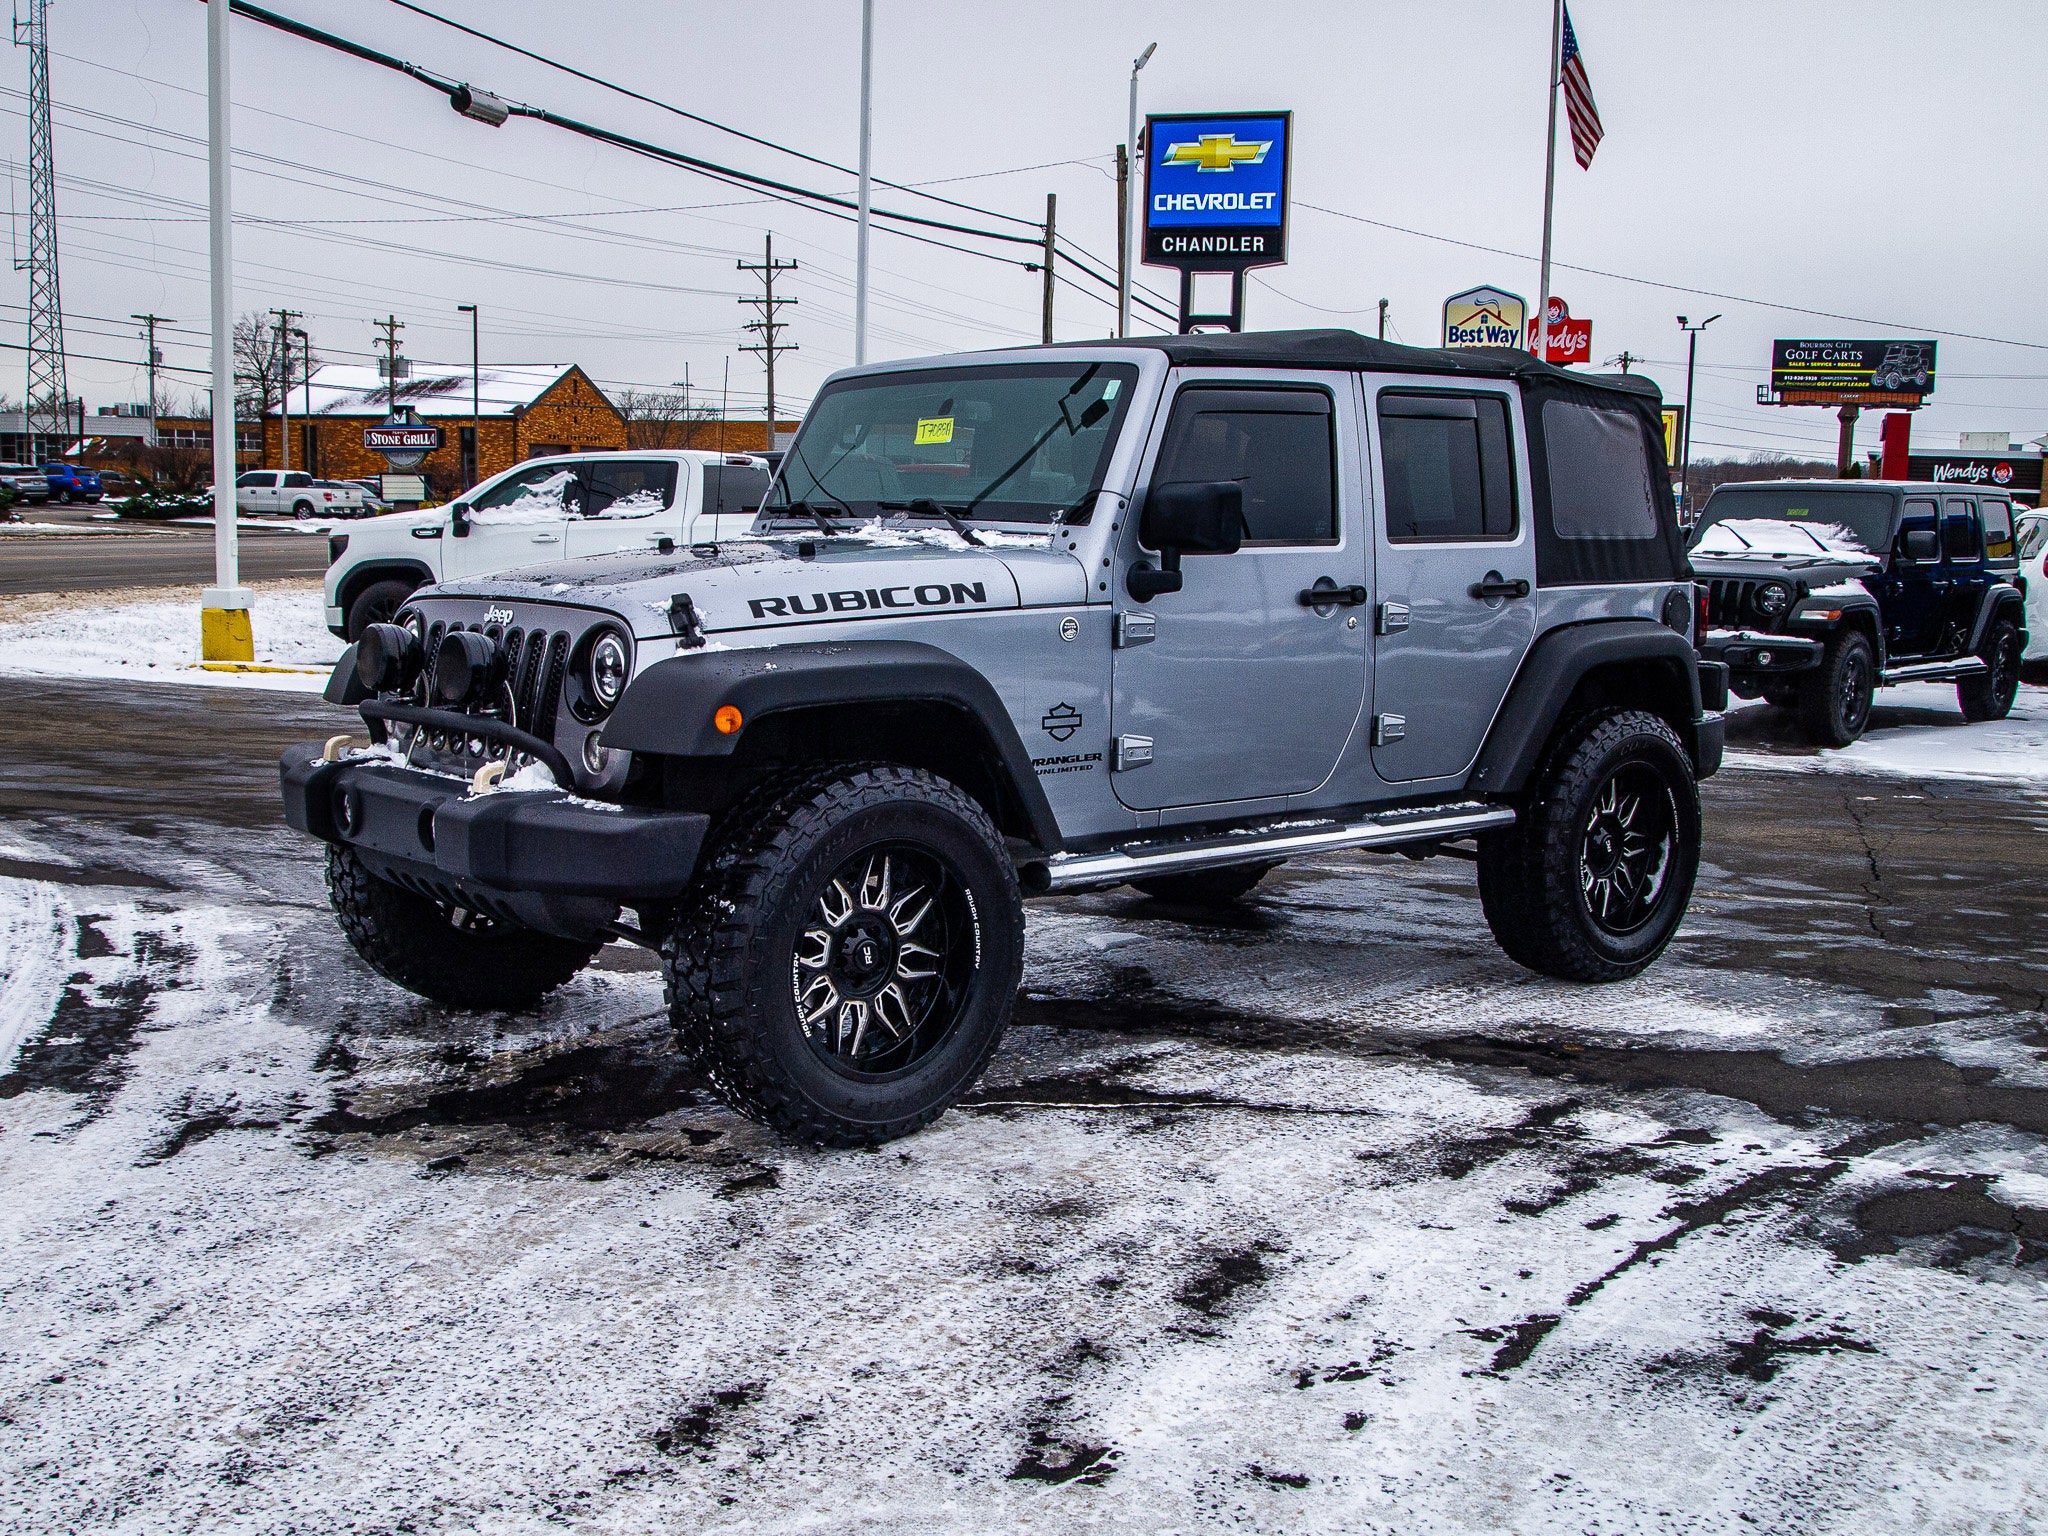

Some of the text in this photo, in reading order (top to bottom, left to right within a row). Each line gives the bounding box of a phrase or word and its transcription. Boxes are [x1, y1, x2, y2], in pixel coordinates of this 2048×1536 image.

[1154, 192, 1276, 211] CHEVROLET
[1162, 236, 1264, 252] CHANDLER
[1448, 326, 1520, 349] Best Way
[1800, 341, 1853, 349] BOURBON CITY
[1785, 349, 1863, 360] GOLF CARTS
[371, 432, 400, 445] STONE
[403, 433, 431, 445] GRILL
[1933, 461, 1989, 483] Wendy's
[747, 581, 987, 619] RUBICON
[484, 604, 514, 627] Jeep
[1035, 764, 1093, 775] UNLIMITED
[964, 888, 981, 970] ROUGH COUNTRY
[863, 946, 873, 965] RC
[792, 952, 812, 1038] ROUGH COUNTRY
